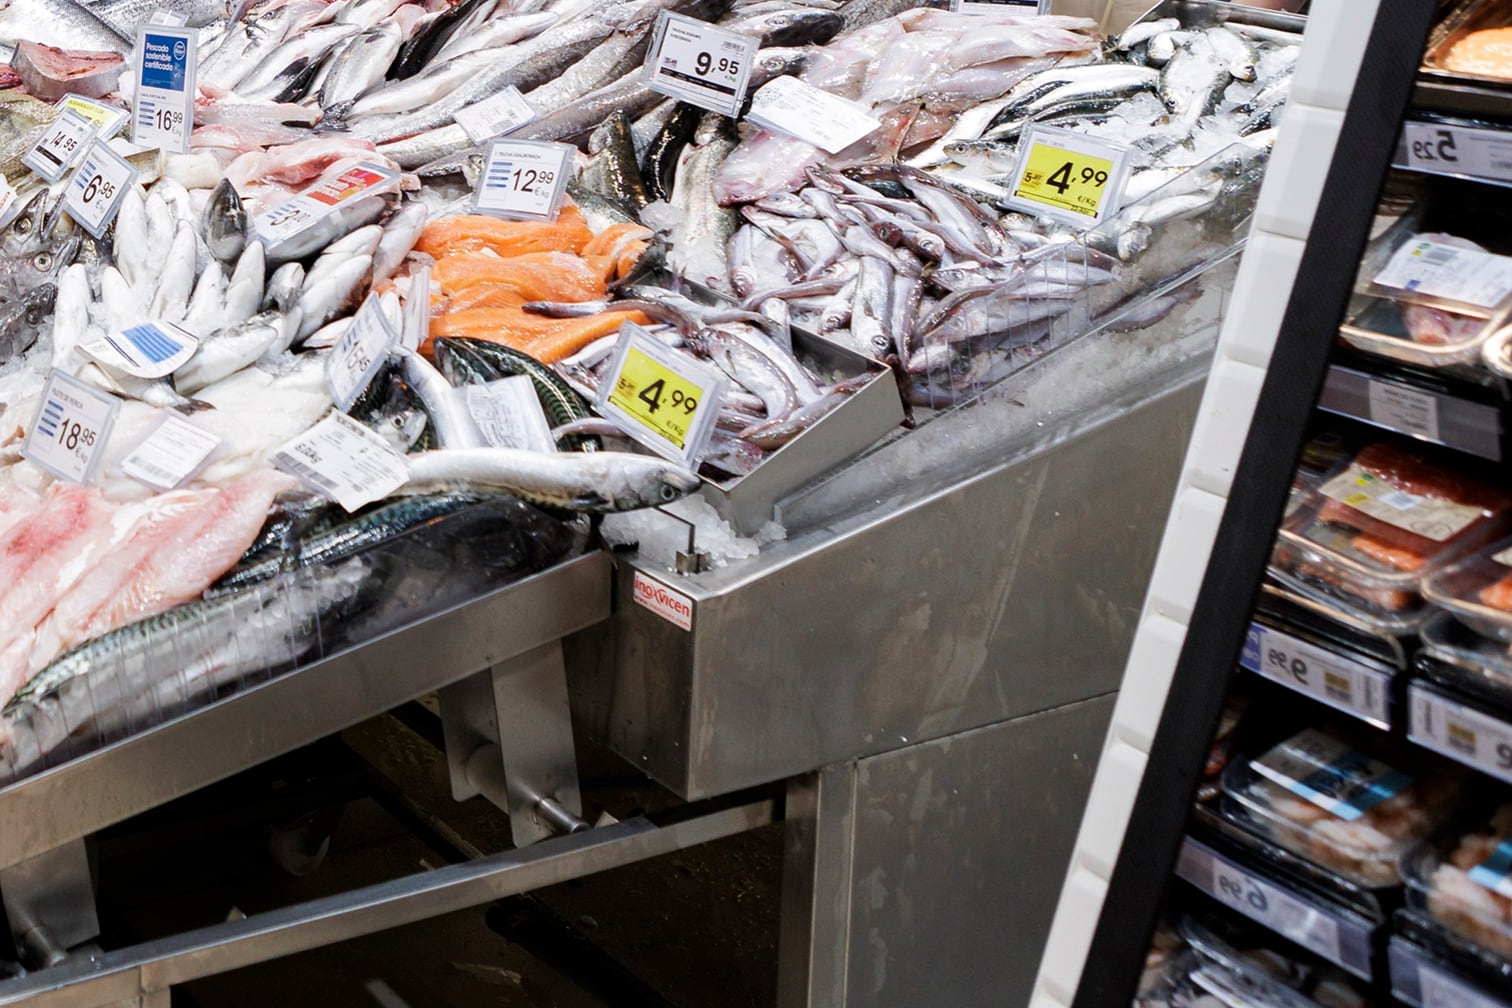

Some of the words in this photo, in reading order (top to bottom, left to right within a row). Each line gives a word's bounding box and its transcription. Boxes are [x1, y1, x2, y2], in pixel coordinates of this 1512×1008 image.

[145, 52, 172, 62] sostenible
[146, 42, 169, 53] Pescado
[144, 61, 174, 72] certificado
[695, 51, 741, 76] 9,95
[82, 174, 116, 204] 6,95
[1046, 161, 1109, 196] 4,99
[638, 378, 697, 416] 4,99
